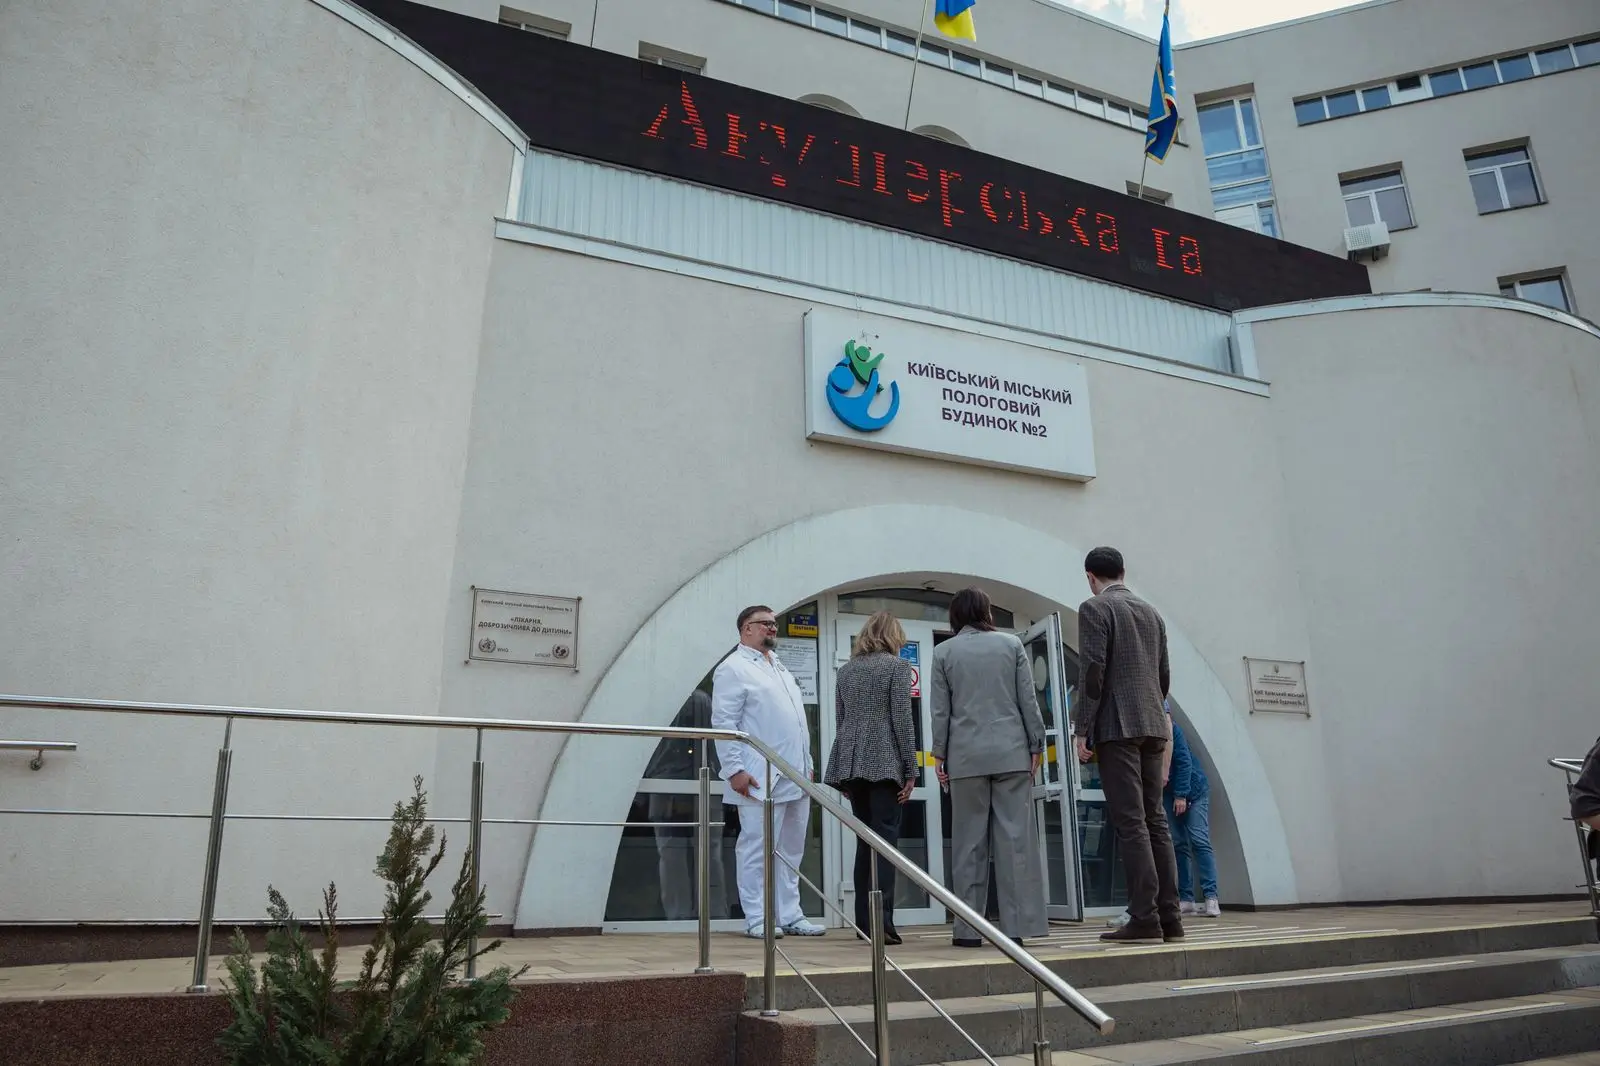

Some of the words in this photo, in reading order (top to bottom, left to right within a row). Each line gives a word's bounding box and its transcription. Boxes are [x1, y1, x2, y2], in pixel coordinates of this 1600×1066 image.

[907, 361, 1000, 391] КИЇВСЬКИЙ
[1003, 379, 1072, 405] МІСЬКИЙ
[942, 388, 1041, 417] ПОЛОГОВИЙ
[941, 407, 1019, 433] БУДИНОК
[1021, 421, 1048, 438] №2
